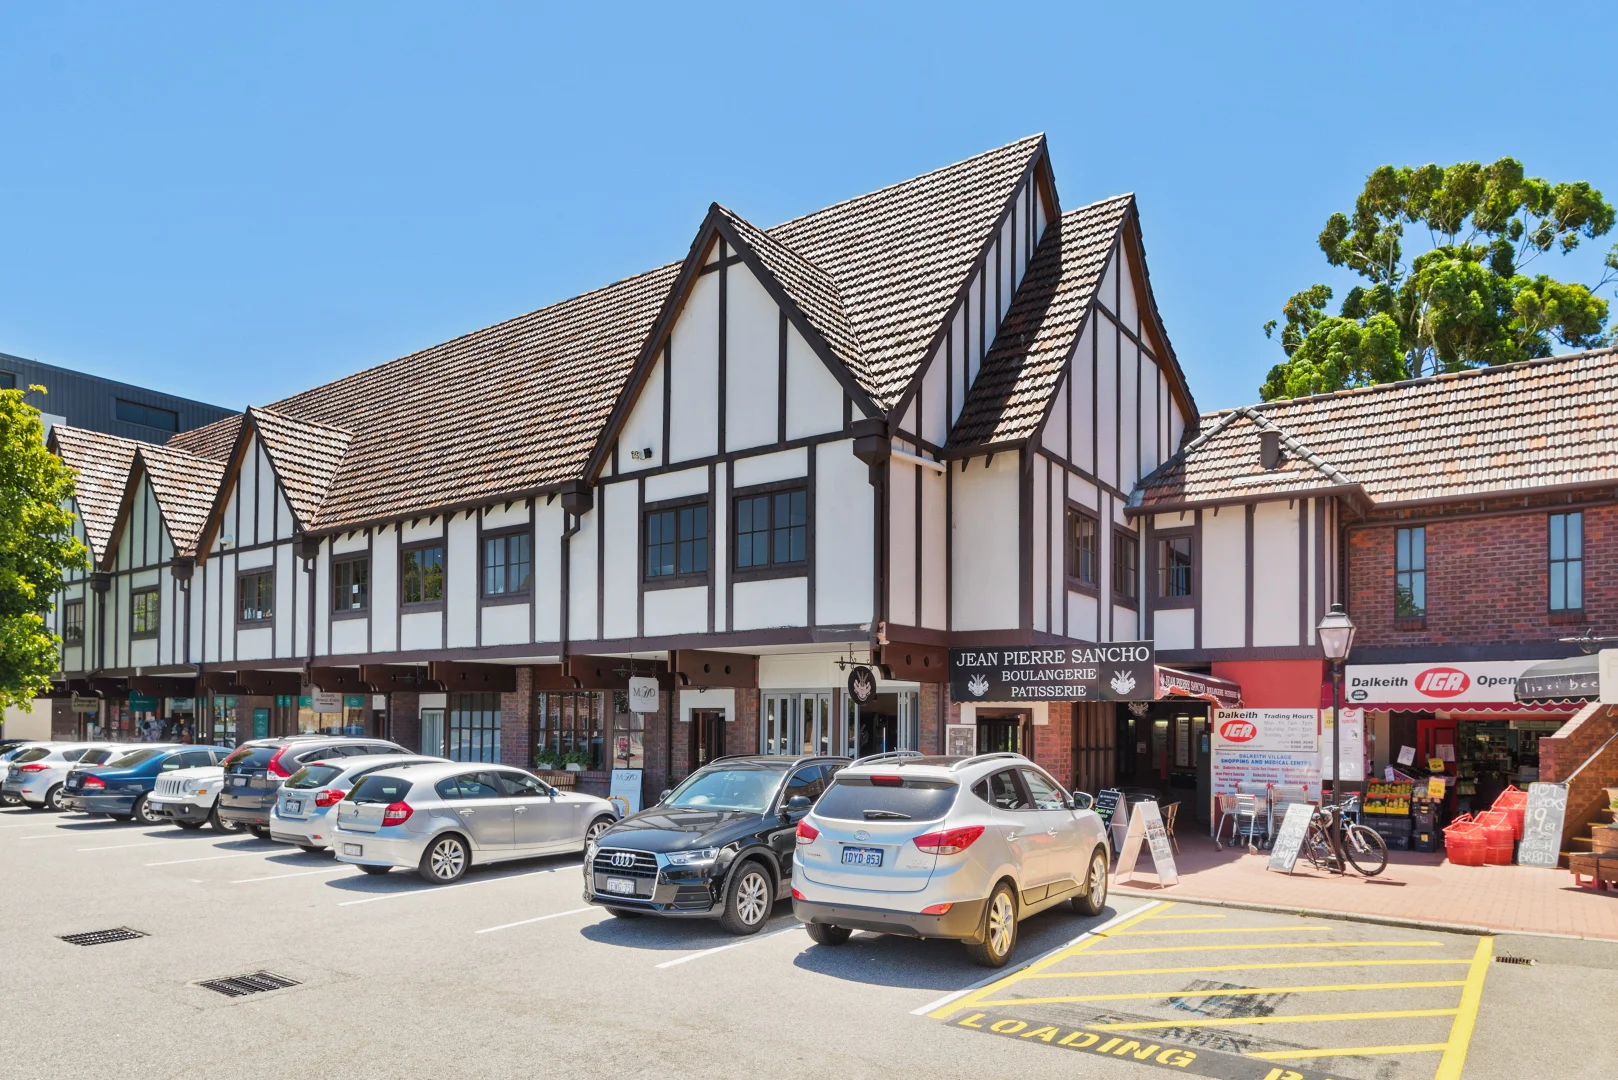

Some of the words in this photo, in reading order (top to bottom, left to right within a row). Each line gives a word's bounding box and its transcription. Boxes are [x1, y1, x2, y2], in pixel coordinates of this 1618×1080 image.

[956, 652, 998, 666] JEAN
[1004, 650, 1065, 665] PIERRE
[1072, 646, 1150, 664] SANCHO
[1002, 668, 1096, 682] BOULANGERIE
[1352, 677, 1408, 687] Dalkeith
[1420, 672, 1465, 691] IGA
[1476, 675, 1517, 686] Open
[1165, 676, 1175, 686] JEAN
[1176, 678, 1190, 690] PIERRE
[1191, 681, 1205, 692] SANCHO
[1524, 682, 1559, 693] lizzi
[1011, 686, 1086, 698] PATISSERIE
[1224, 724, 1253, 737] IGA
[1530, 784, 1558, 797] HOT
[1528, 798, 1566, 810] CHOOKS
[1522, 838, 1553, 852] FRESH
[1519, 851, 1554, 864] BREAD
[958, 1013, 1197, 1068] LOADING
